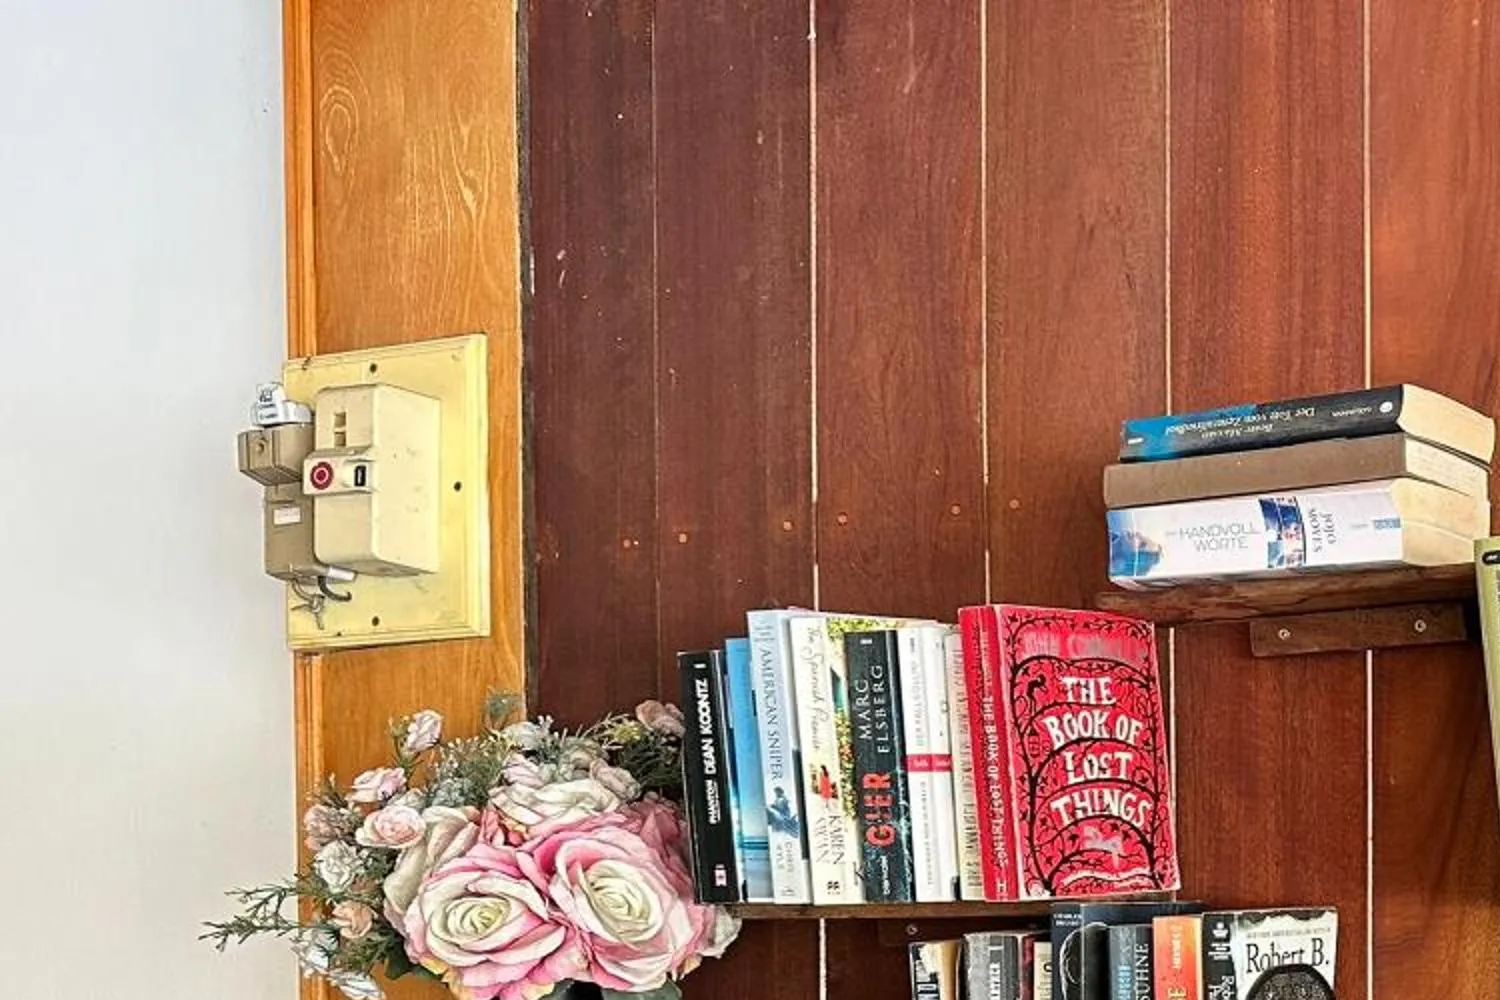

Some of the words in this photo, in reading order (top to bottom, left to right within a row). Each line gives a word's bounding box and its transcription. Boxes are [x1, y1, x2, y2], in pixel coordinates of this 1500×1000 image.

[1178, 521, 1260, 540] HANDVOLL
[1193, 536, 1250, 553] WORTE
[694, 677, 711, 732] KOONTZ
[758, 648, 779, 722] AMERICAN
[1059, 675, 1117, 706] THE
[854, 678, 874, 741] MARC
[872, 663, 891, 754] ELSBERG
[982, 694, 994, 722] THE
[985, 724, 999, 760] BOOK
[1042, 709, 1110, 751] BOOK
[1115, 713, 1145, 745] OF
[703, 731, 718, 776] DEAN
[766, 721, 786, 781] SNIPER
[1062, 750, 1134, 786] LOST
[987, 763, 998, 780] OF
[1049, 787, 1153, 828] THINGS
[1245, 941, 1308, 974] Robert
[1310, 936, 1331, 968] B.
